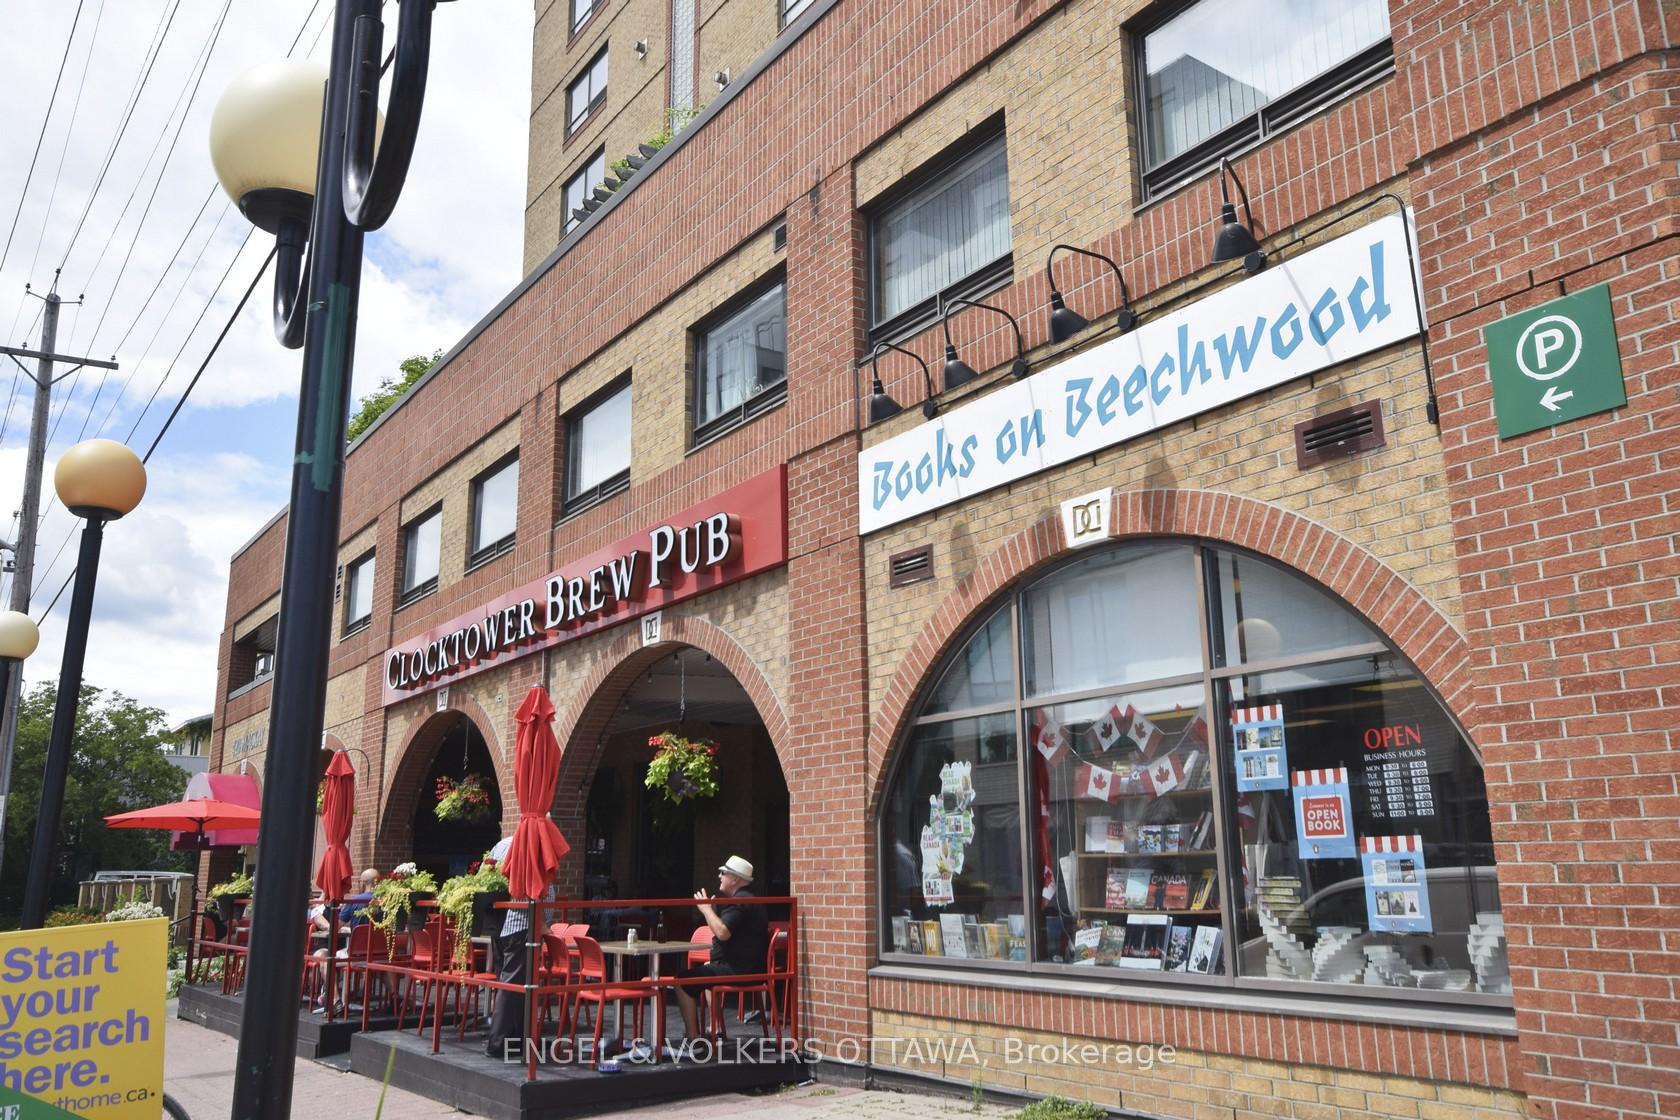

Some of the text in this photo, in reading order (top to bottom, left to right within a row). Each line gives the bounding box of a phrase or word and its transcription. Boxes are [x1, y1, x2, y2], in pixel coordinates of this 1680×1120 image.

[1534, 328, 1565, 370] P
[872, 240, 1391, 511] Books on Beechwood
[386, 512, 731, 690] CLOCKTOWER BREW PUB
[1364, 724, 1421, 749] OPEN
[1364, 748, 1426, 761] BUSINESS HOURS
[1307, 809, 1338, 820] OPEN
[1308, 820, 1340, 831] BOOK
[2, 940, 119, 983] Start
[0, 984, 100, 1030] your
[0, 1008, 149, 1059] search
[0, 1059, 110, 1094] here.
